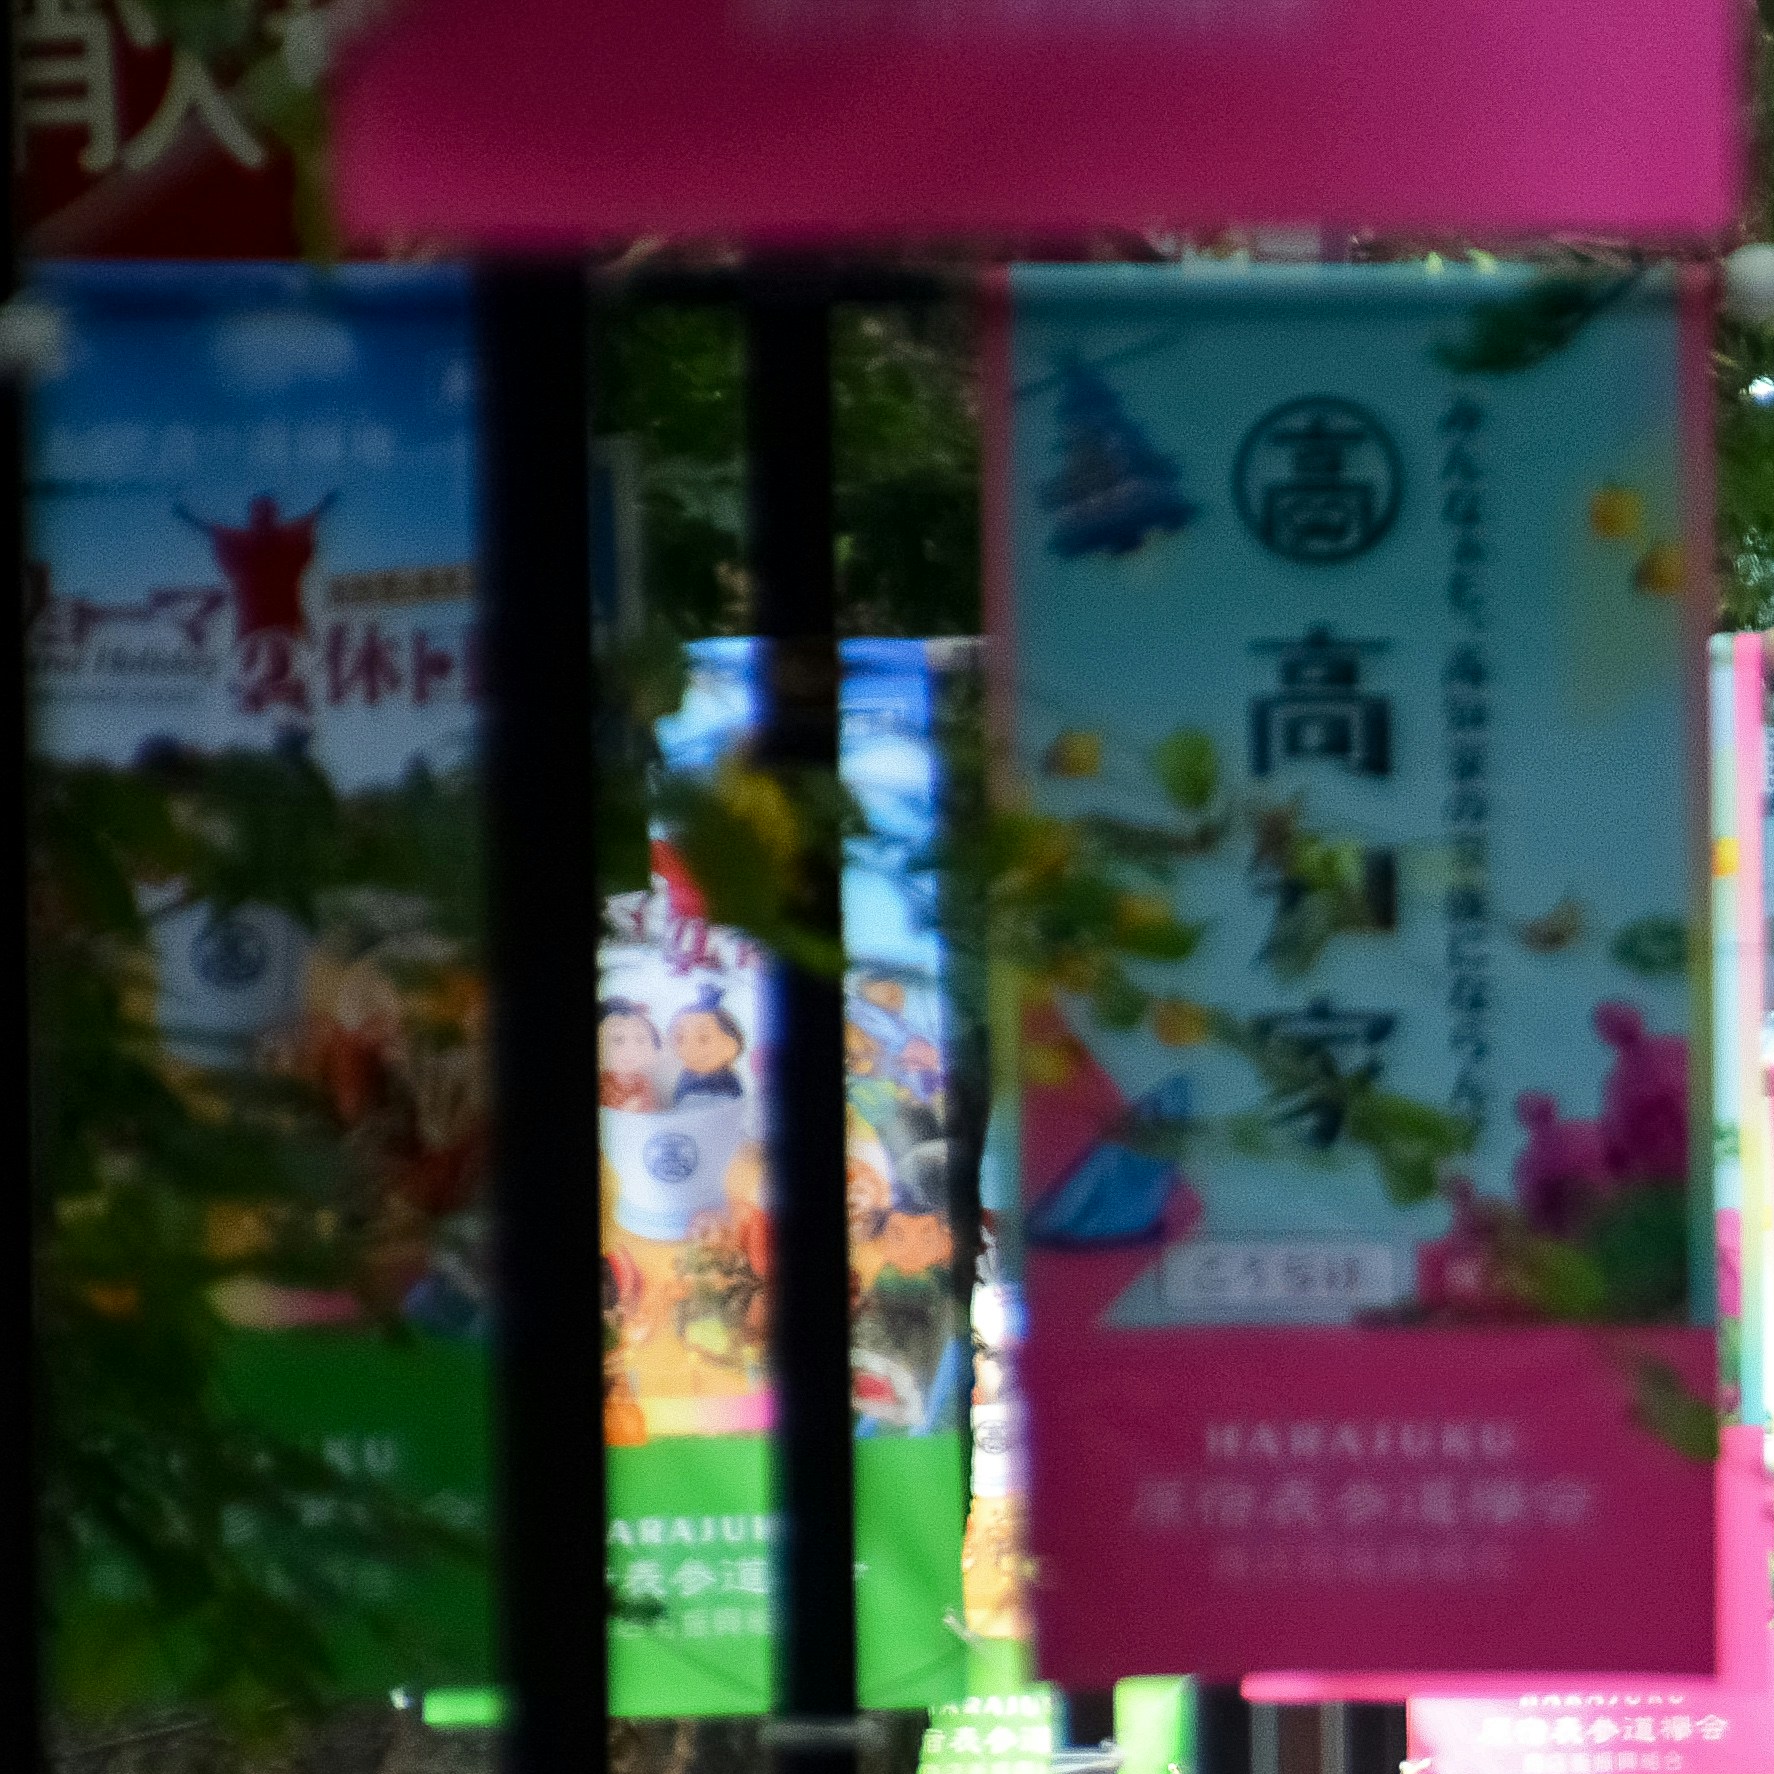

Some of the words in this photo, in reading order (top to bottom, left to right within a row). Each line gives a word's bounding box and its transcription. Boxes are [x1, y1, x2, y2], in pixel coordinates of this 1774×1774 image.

[1204, 1420, 1518, 1459] HARAJUKU
[606, 1557, 770, 1599] 表参道
